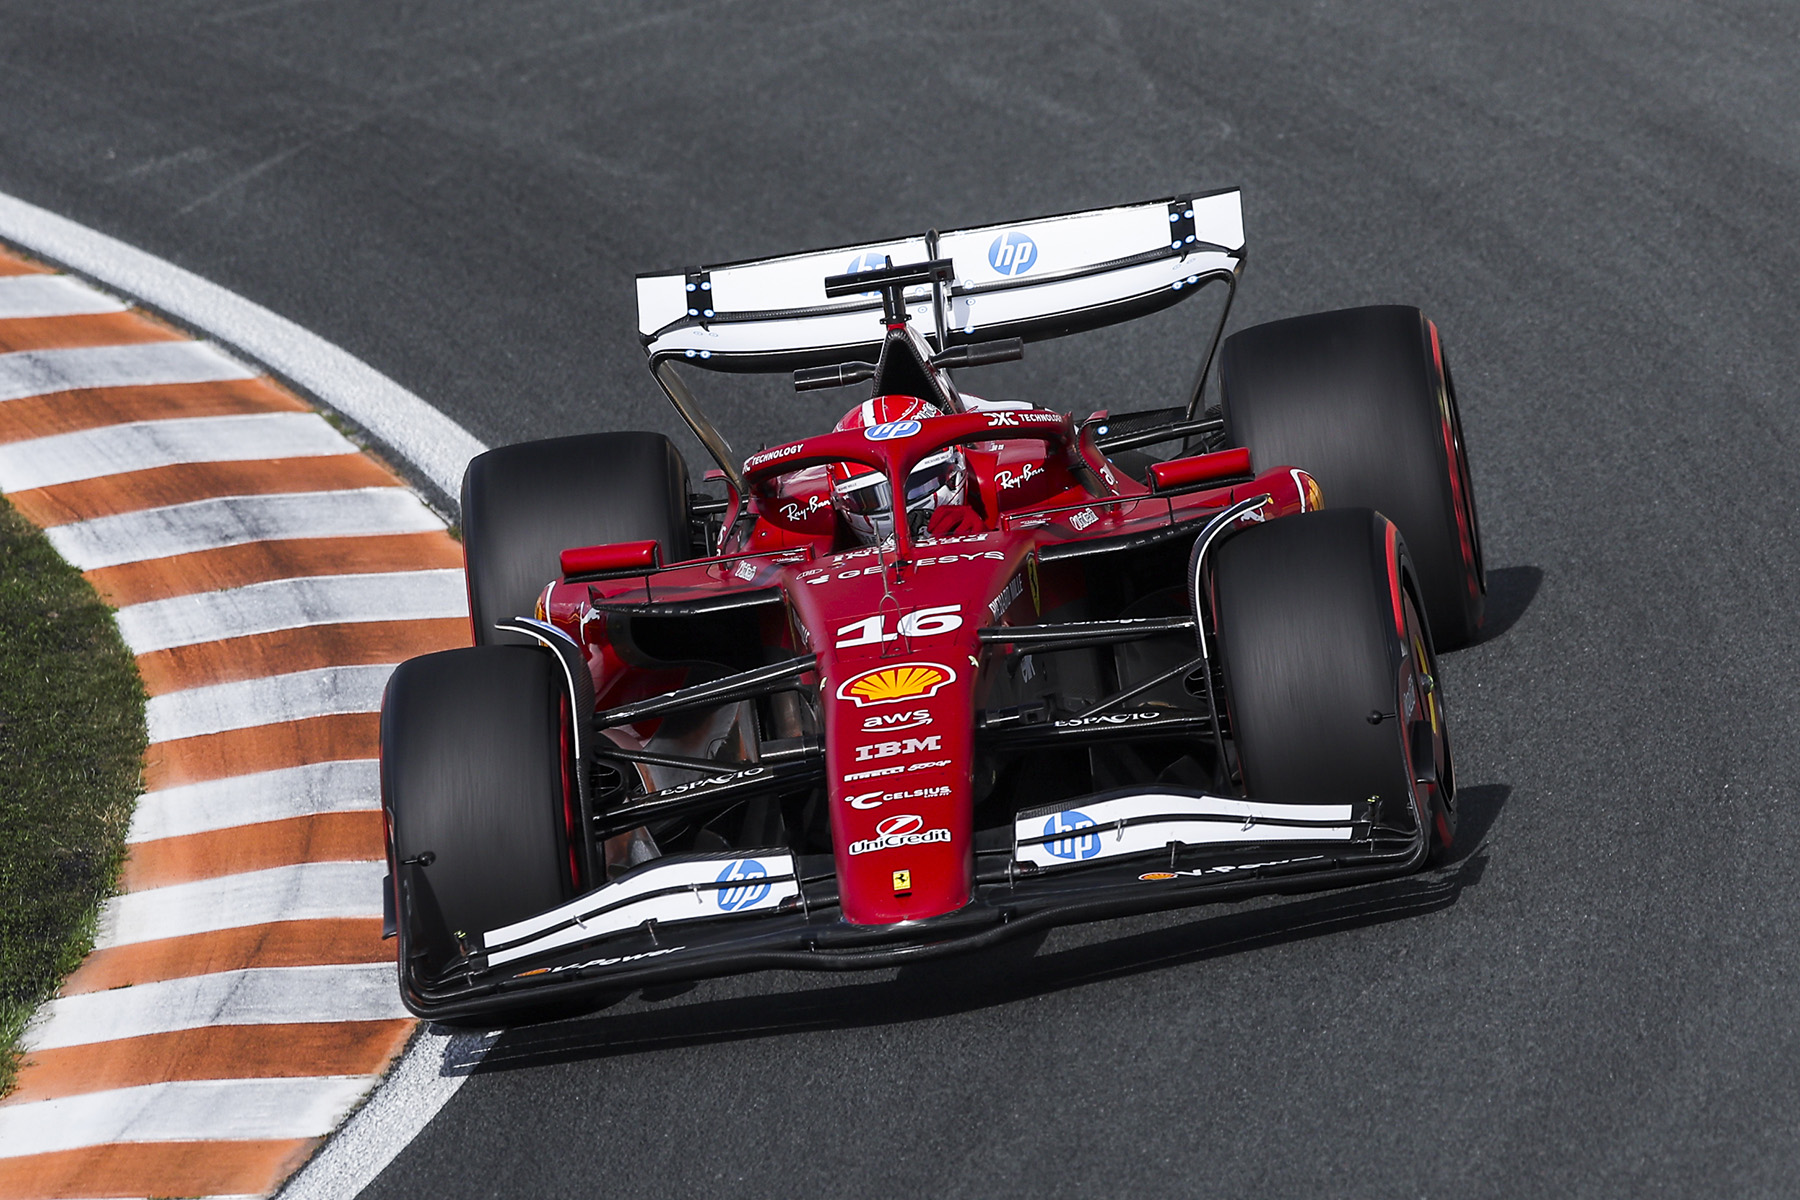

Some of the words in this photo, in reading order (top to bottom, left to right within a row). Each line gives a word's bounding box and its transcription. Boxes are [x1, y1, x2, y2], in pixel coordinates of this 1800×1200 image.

[990, 232, 1036, 276] hp
[752, 444, 804, 466] TECHNOLOGY
[838, 551, 1005, 580] GEESYS
[836, 604, 963, 649] 16
[863, 709, 931, 728] aws
[856, 735, 942, 762] IBM
[883, 786, 950, 801] CELSIUS
[850, 829, 951, 854] UniCredit
[1046, 811, 1098, 860] hp
[718, 859, 769, 911] hp
